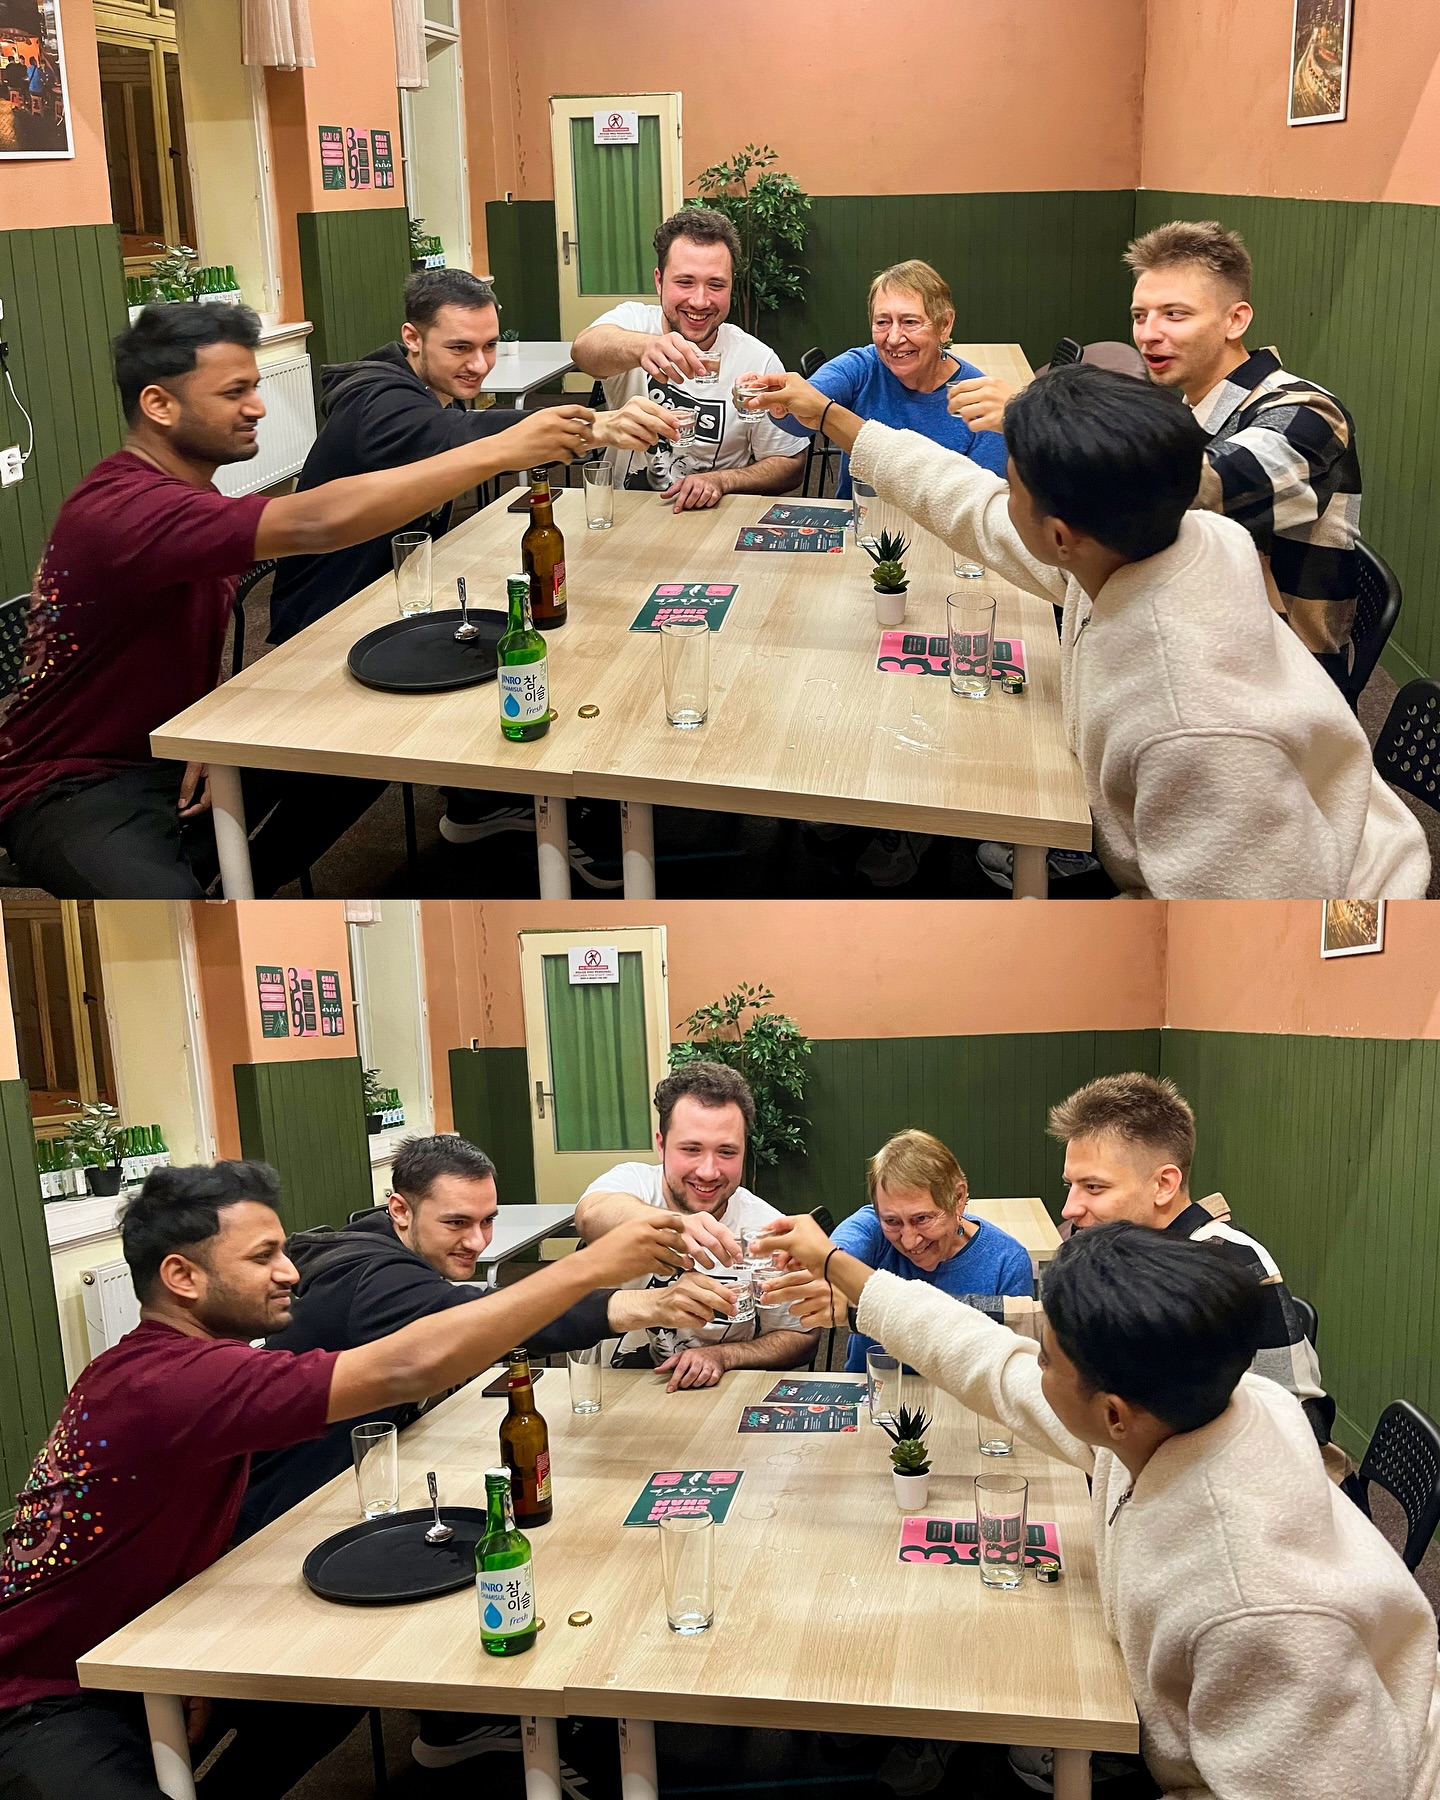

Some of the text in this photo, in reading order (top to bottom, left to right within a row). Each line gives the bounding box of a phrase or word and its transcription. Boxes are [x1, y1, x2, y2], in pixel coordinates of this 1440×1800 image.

[501, 674, 521, 685] JINRO
[523, 674, 537, 691] 참
[525, 685, 546, 703] 이슬
[526, 704, 543, 716] fresh
[480, 1581, 503, 1593] JINRO
[506, 1580, 521, 1598] 참
[508, 1591, 531, 1611] 이슬
[510, 1613, 529, 1627] fresh
